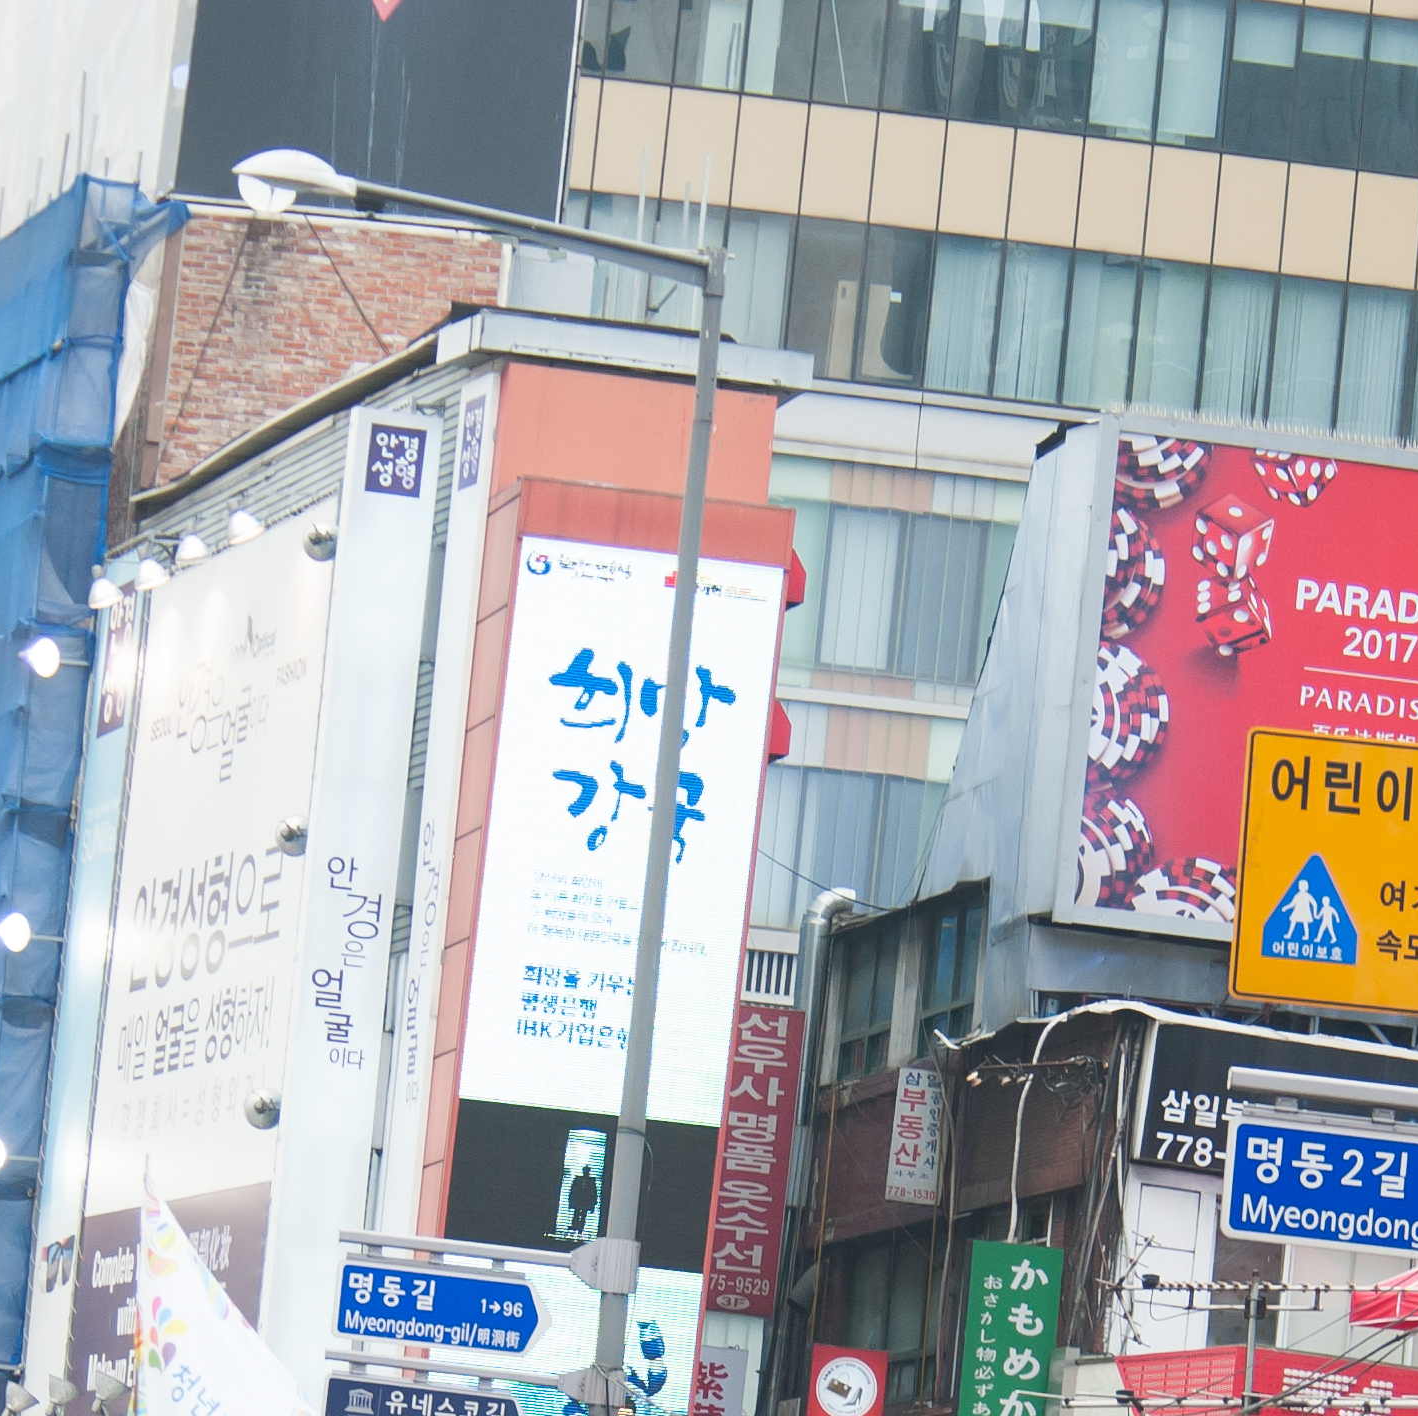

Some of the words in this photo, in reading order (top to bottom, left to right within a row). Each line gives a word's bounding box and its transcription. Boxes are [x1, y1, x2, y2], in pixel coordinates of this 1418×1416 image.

[370, 459, 418, 492] 성형
[374, 429, 420, 461] 안경
[276, 656, 308, 690] FASHION
[1343, 626, 1418, 664] 2017
[327, 857, 382, 970] 안경은
[1272, 940, 1344, 963] 어린이보호
[118, 1011, 150, 1082] 매일
[151, 997, 201, 1076] 얼굴을
[203, 975, 274, 1063] 성형하자!
[311, 969, 365, 1072] 얼굴이다
[729, 1012, 789, 1107] 선우사
[722, 1110, 777, 1175] 명품
[894, 1087, 928, 1168] 부동산
[1246, 1136, 1409, 1200] 명동2길
[712, 1180, 772, 1274] 옷수선
[91, 1248, 135, 1293] Complete
[348, 1272, 437, 1312] 명동길
